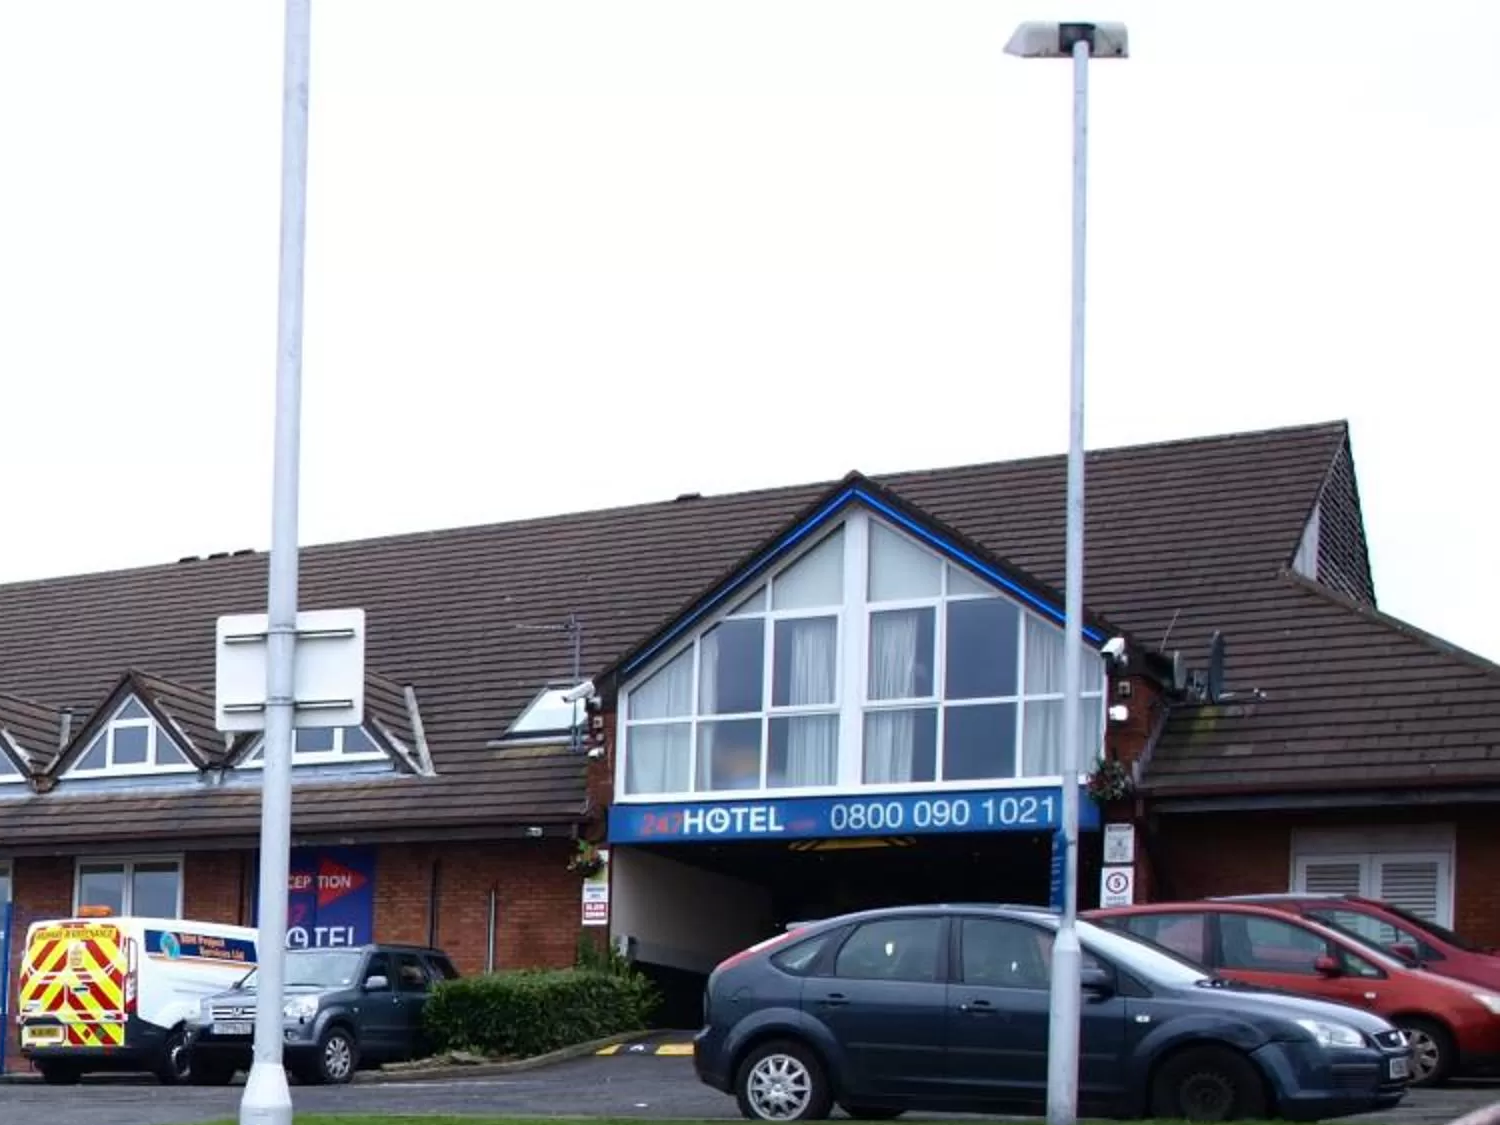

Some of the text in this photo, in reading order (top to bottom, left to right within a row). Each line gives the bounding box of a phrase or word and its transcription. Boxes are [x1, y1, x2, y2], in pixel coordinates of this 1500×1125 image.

[830, 802, 904, 830] 0800
[913, 800, 970, 827] 090
[982, 796, 1054, 825] 1021
[288, 874, 351, 889] CEPTION
[1114, 877, 1121, 889] 5
[285, 926, 355, 948] OTEL
